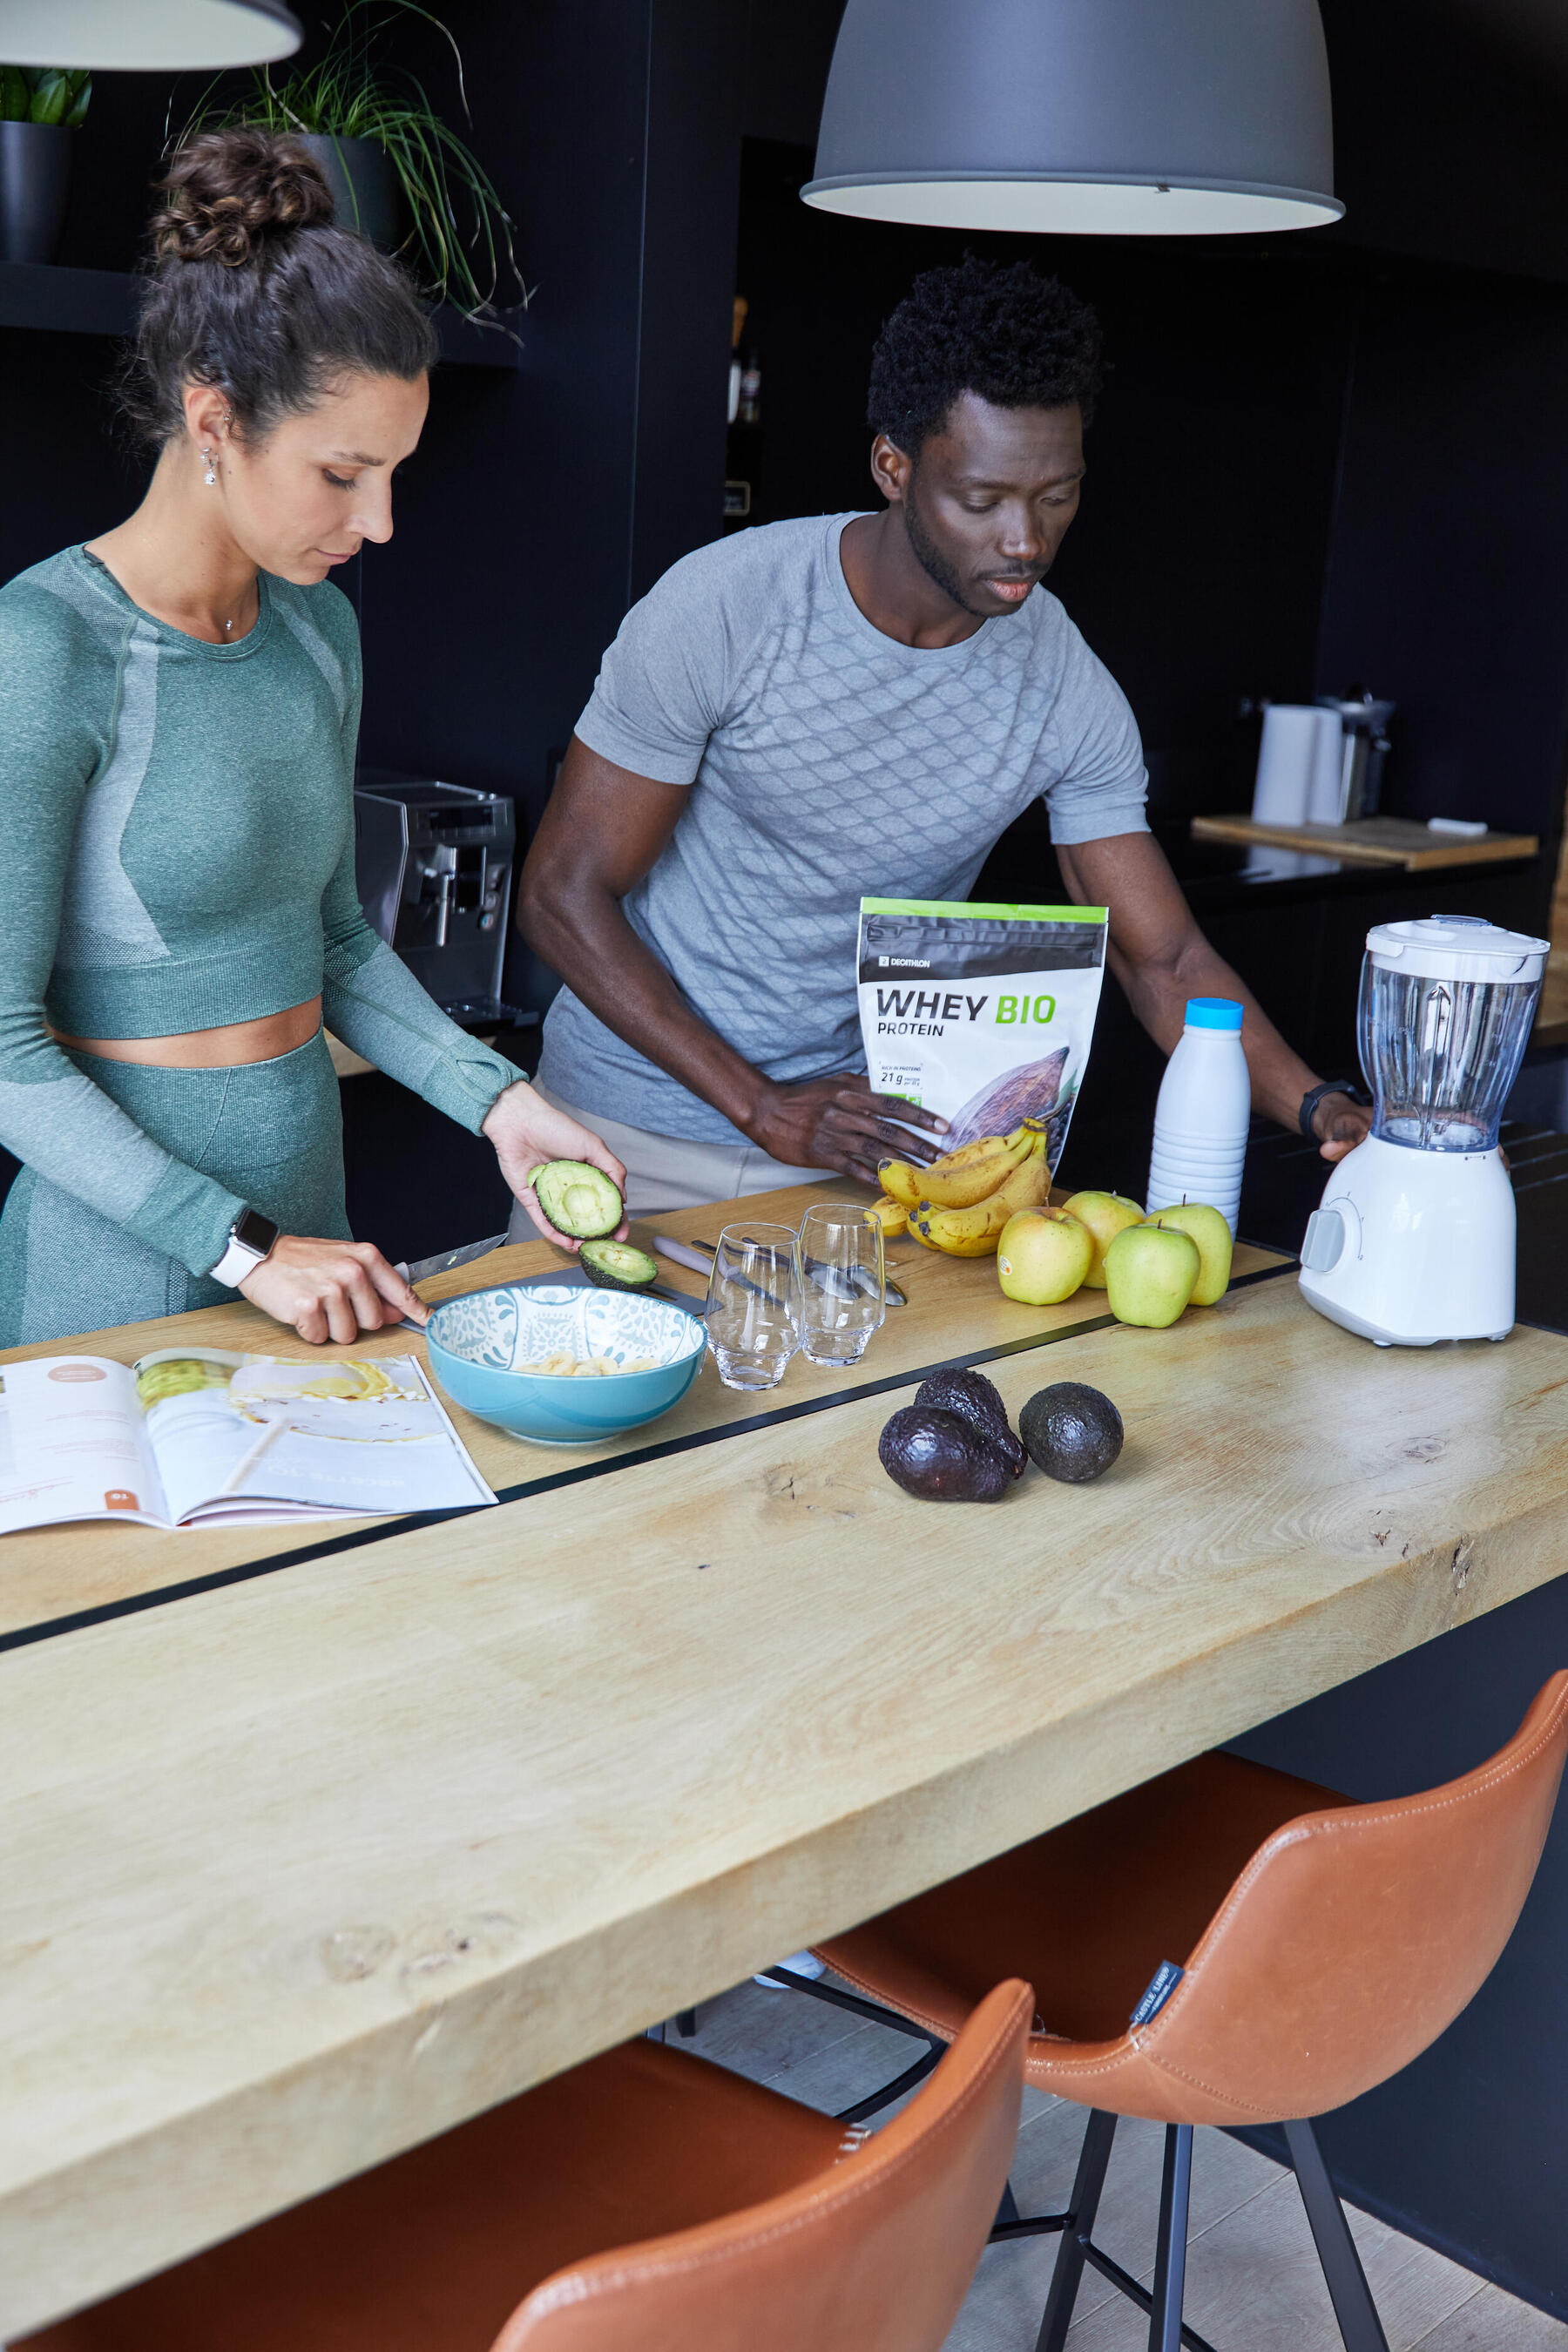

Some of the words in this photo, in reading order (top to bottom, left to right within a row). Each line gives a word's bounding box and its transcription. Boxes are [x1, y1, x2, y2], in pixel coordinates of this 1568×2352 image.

[891, 958, 930, 969] DECATHLON
[876, 988, 989, 1021] WHEY
[995, 995, 1056, 1024] BIO
[877, 1022, 944, 1037] PROTEIN
[881, 1071, 894, 1082] 21
[896, 1074, 903, 1085] g
